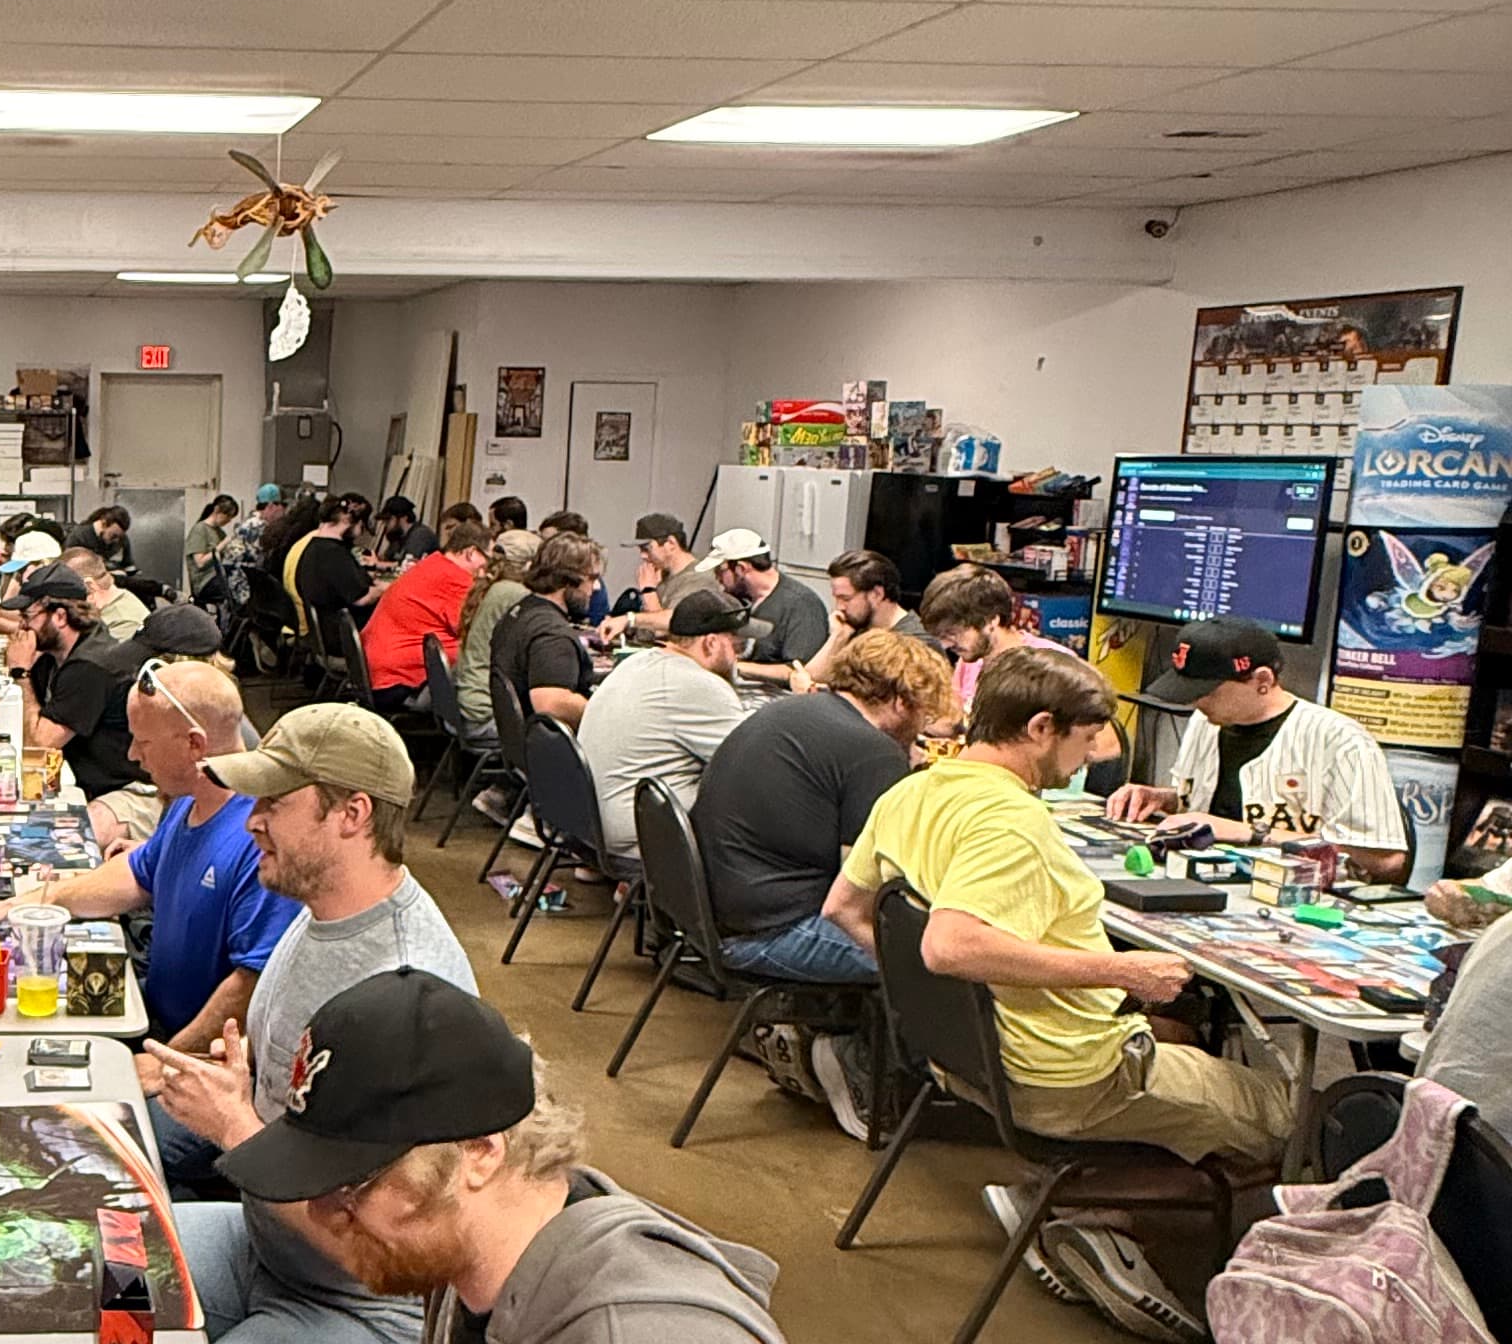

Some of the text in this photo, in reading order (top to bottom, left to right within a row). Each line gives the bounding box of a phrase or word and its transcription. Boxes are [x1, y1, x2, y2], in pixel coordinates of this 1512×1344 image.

[142, 346, 170, 368] EXIT
[1416, 423, 1485, 449] Disney
[1381, 479, 1508, 492] TRADING CARD GAME
